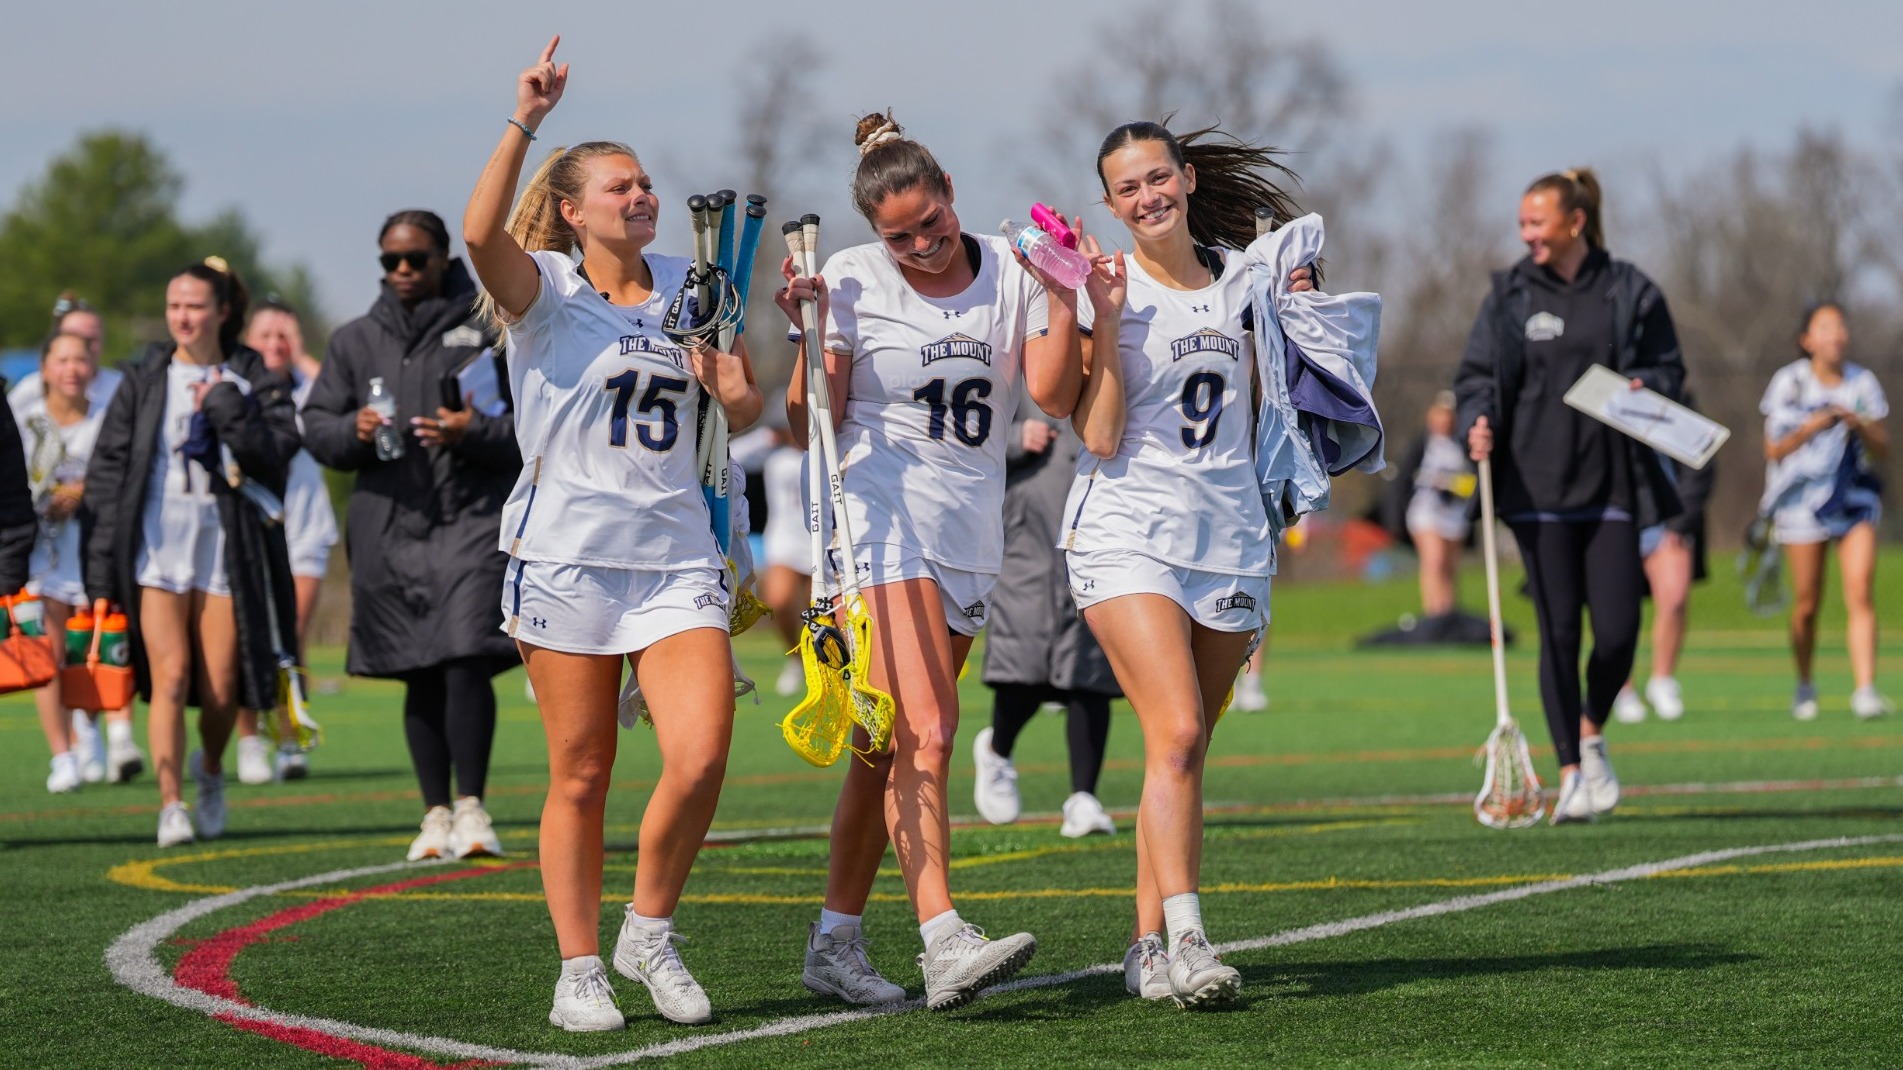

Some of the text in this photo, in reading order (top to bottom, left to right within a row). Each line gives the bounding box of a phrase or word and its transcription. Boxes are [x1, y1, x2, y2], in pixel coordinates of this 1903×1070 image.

[620, 335, 647, 355] THE
[921, 341, 992, 366] THE MOUNT
[1172, 335, 1239, 361] THE MOUNT
[605, 367, 689, 454] 15
[912, 376, 993, 448] 16
[1179, 370, 1226, 450] 9
[830, 474, 843, 505] GAIT
[811, 500, 820, 533] GAIT
[694, 595, 711, 609] THE
[1216, 597, 1256, 612] THE MOUNT
